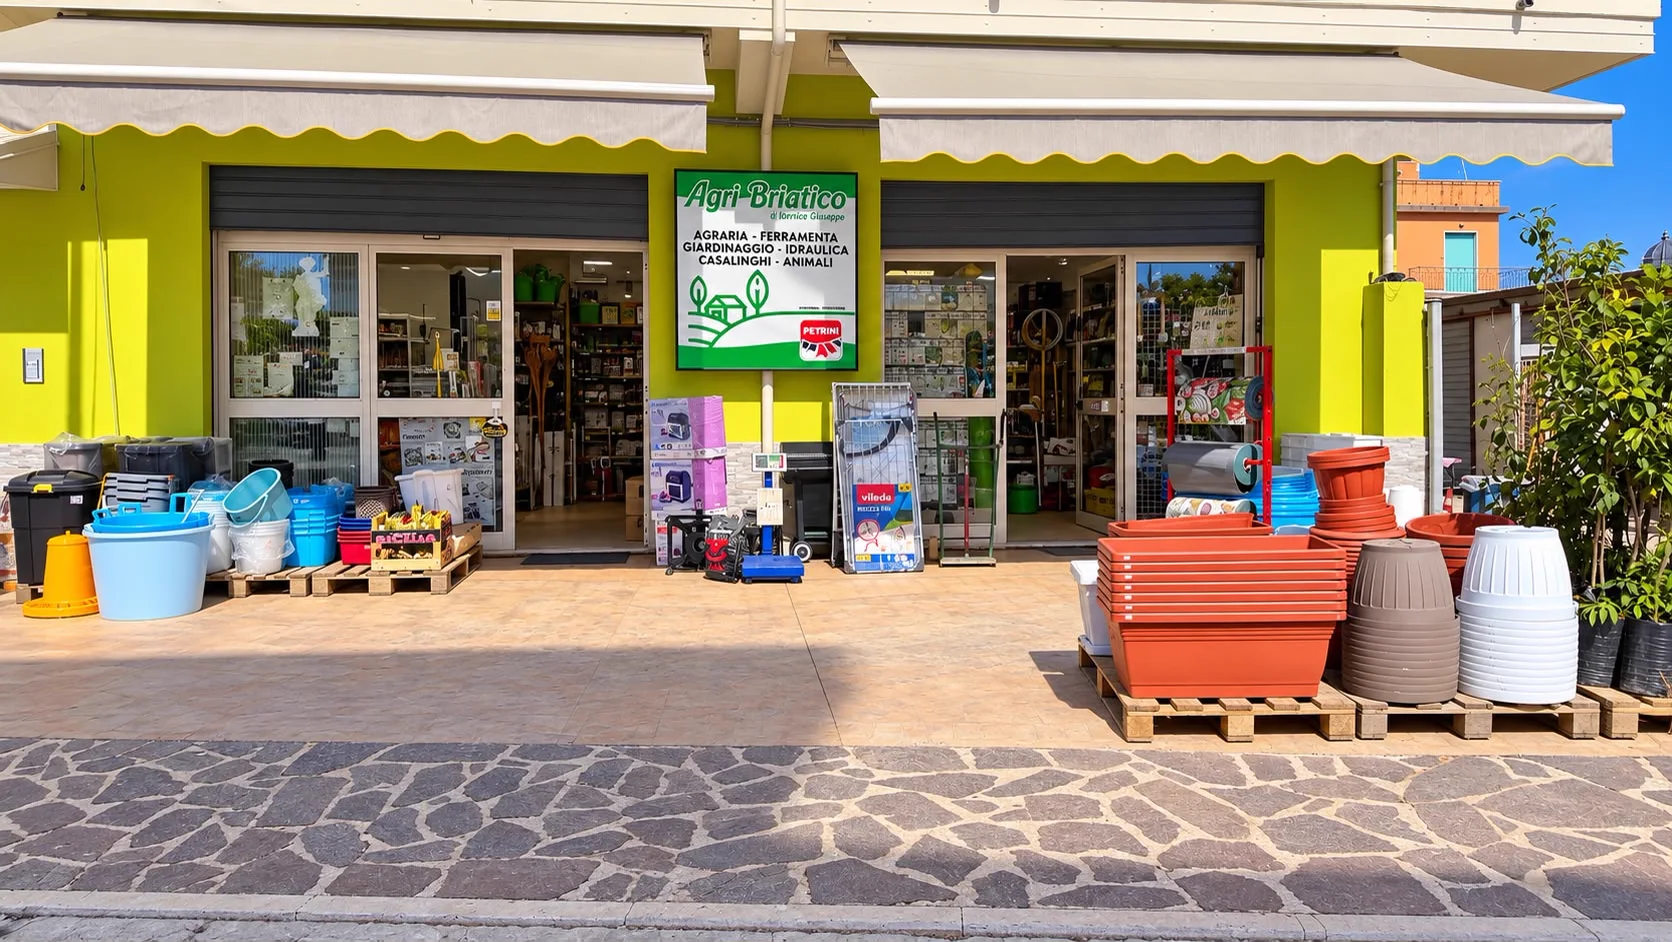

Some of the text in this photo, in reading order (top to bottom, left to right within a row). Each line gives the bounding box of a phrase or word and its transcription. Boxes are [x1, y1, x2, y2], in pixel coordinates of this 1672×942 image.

[684, 180, 847, 213] Agri Briatico
[693, 230, 748, 241] AGRARIA
[760, 231, 838, 243] FERRAMENTA
[683, 242, 774, 254] GIARDINAGGIO
[785, 244, 849, 255] IDRAULICA
[698, 255, 772, 266] CASALINGHI
[783, 256, 833, 267] ANIMALI
[803, 326, 839, 335] PETRINI
[861, 492, 892, 502] vileda
